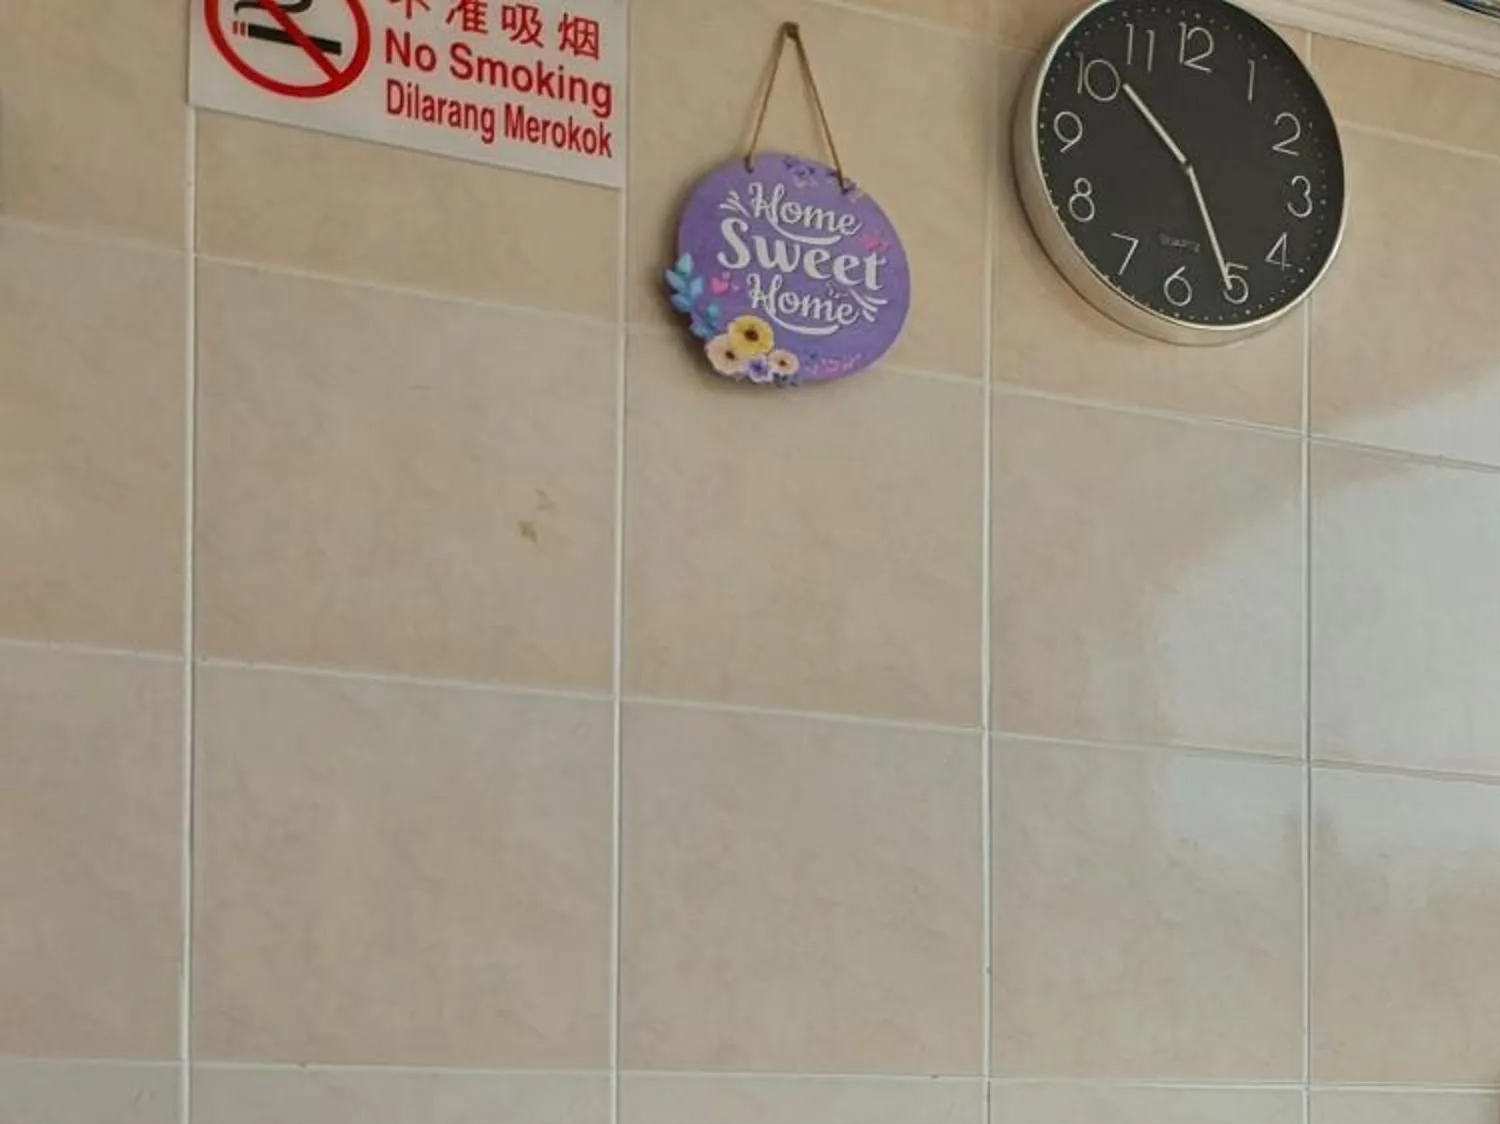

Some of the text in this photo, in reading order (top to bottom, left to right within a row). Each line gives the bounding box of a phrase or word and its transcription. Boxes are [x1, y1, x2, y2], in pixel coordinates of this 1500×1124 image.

[1125, 23, 1156, 73] 11
[1179, 21, 1215, 73] 12
[385, 28, 612, 119] No Smoking
[1076, 52, 1121, 102] 10
[1247, 58, 1256, 103] 1
[386, 78, 612, 158] Dilarang Merokok
[1053, 111, 1083, 153] 9
[1271, 111, 1301, 156] 2
[748, 182, 862, 245] Home
[1068, 177, 1096, 222] 8
[1286, 175, 1313, 218] 3
[716, 217, 887, 291] Sweet
[1111, 232, 1139, 275] 7
[1264, 232, 1293, 271] 4
[746, 273, 859, 335] Home
[1163, 265, 1193, 306] 6
[1223, 261, 1249, 304] 5
